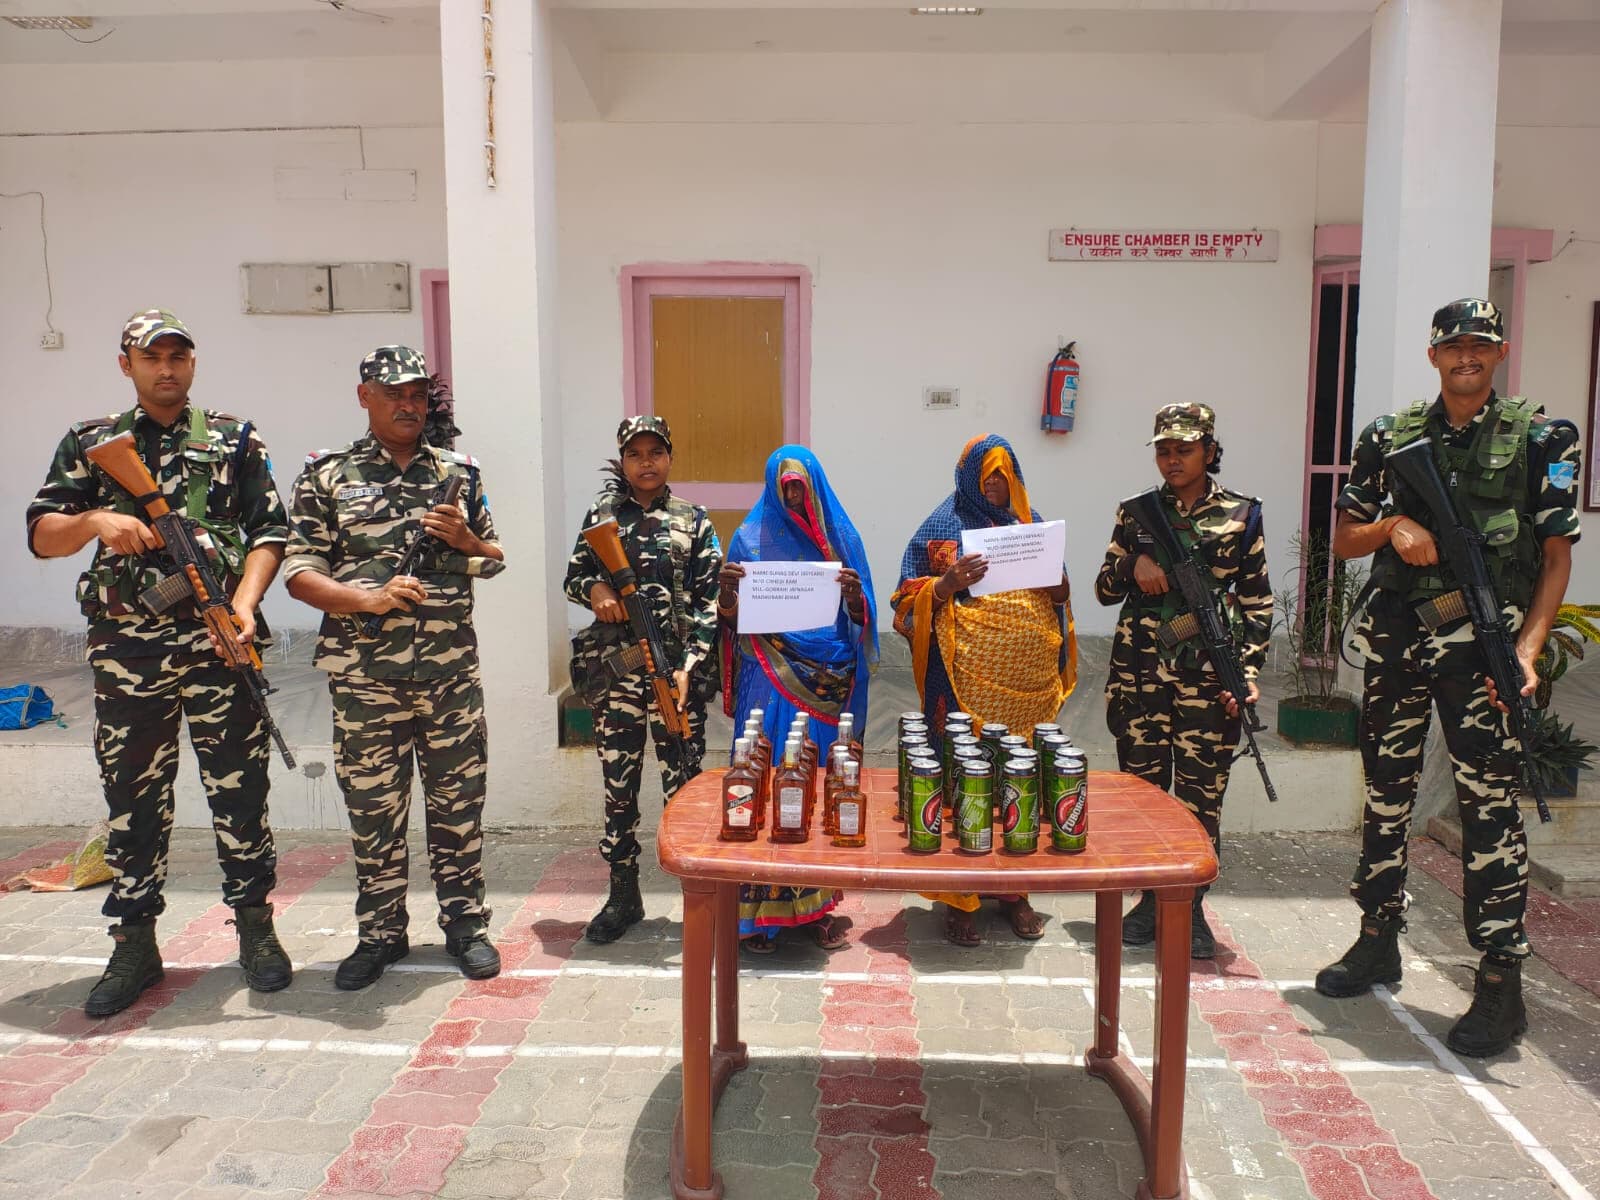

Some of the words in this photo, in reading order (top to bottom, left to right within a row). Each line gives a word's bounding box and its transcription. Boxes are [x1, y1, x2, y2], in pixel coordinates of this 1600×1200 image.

[1065, 233, 1120, 246] ENSURE
[1125, 233, 1190, 246] CHAMBER
[1195, 233, 1208, 246] IS
[1212, 233, 1263, 246] EMPTY
[1061, 793, 1086, 833] TUBORG
